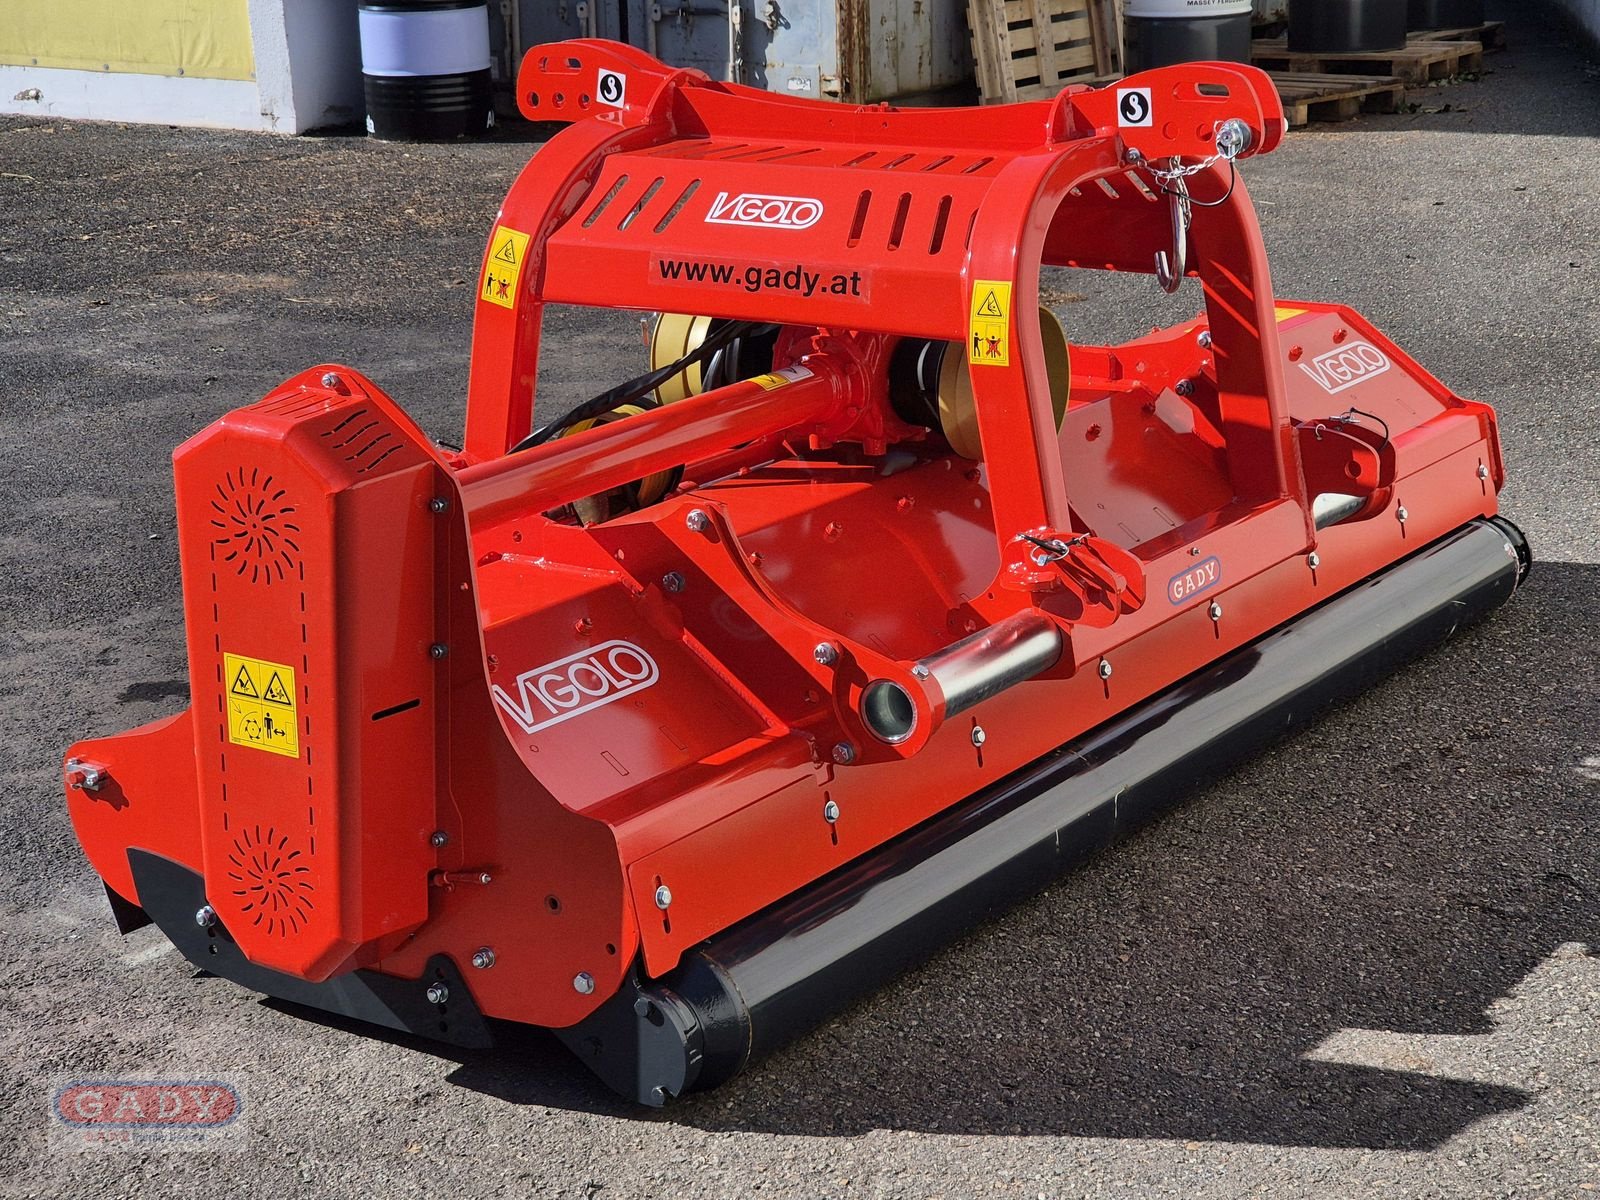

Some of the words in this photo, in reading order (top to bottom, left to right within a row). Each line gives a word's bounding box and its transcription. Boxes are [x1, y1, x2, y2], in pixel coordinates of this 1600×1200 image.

[704, 191, 824, 229] VIGOLO
[659, 259, 862, 296] www.gady.at
[1298, 340, 1391, 394] VIGOLO
[1172, 561, 1216, 599] GADY
[491, 639, 660, 734] VIGOLO
